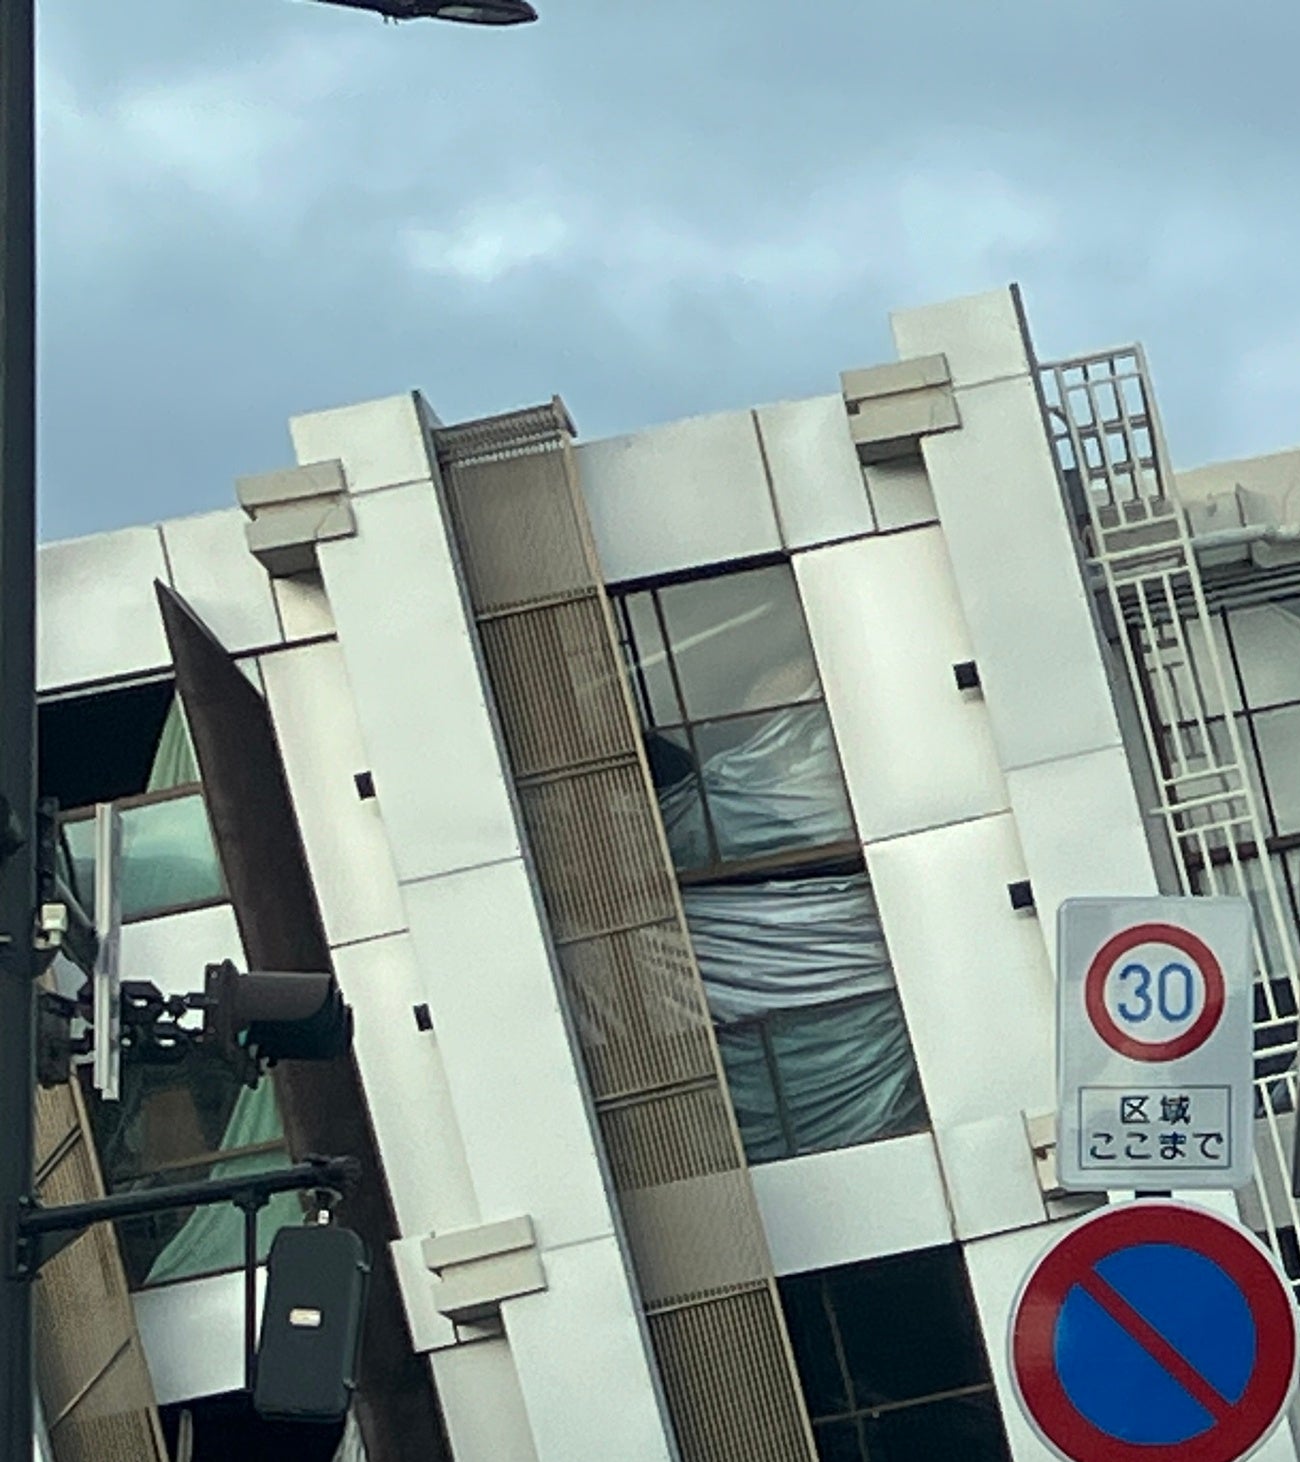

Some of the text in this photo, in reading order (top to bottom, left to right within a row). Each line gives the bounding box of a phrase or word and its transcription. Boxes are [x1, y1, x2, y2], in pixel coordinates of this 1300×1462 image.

[1116, 962, 1194, 1024] 30
[1120, 1094, 1192, 1126] 区域
[1090, 1131, 1224, 1162] ここまで
